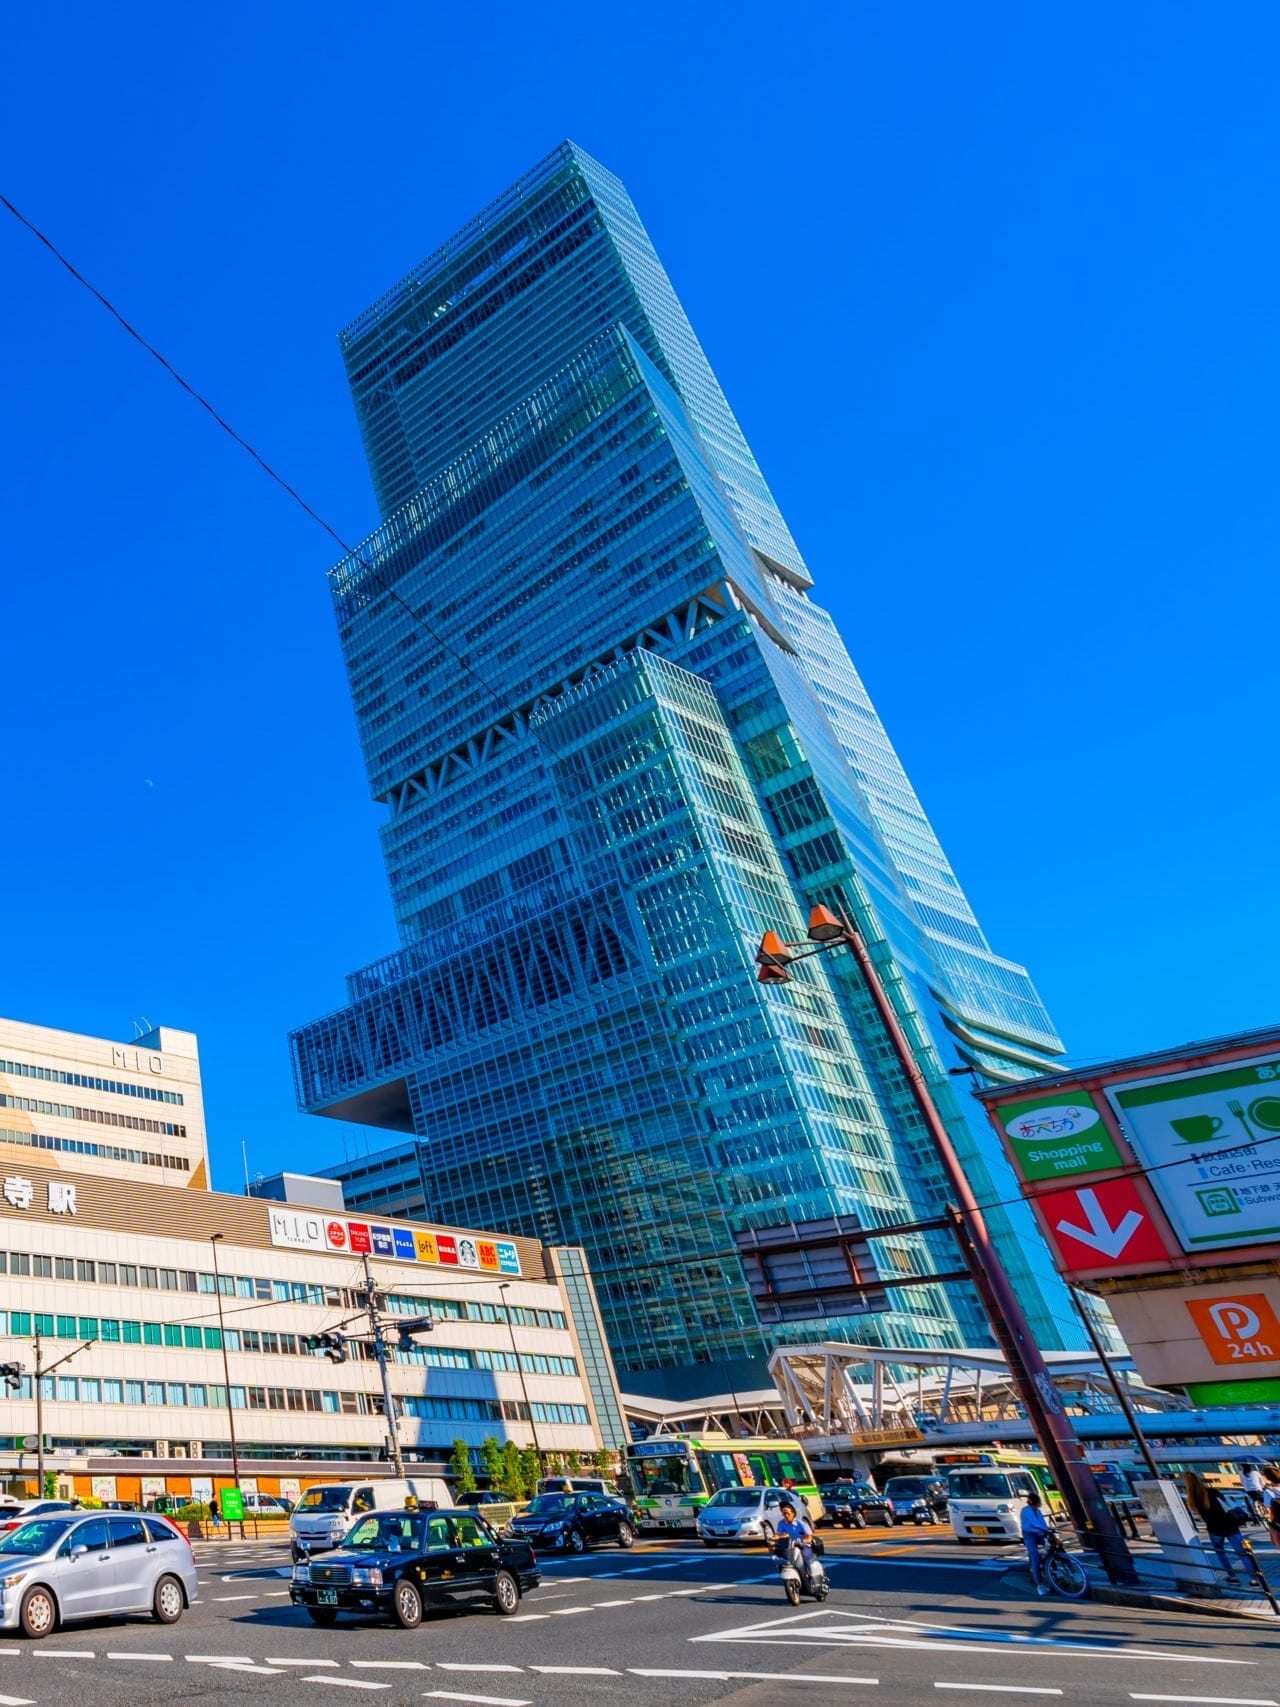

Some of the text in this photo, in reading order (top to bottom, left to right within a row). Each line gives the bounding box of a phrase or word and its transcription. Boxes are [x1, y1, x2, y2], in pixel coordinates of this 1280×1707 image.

[111, 1046, 164, 1075] MIO
[1020, 1117, 1075, 1138] あべちか
[1028, 1142, 1104, 1162] Shopping
[1053, 1155, 1088, 1170] mall
[272, 1214, 320, 1241] MIO
[395, 1240, 414, 1248] PLAZA
[479, 1245, 495, 1257] ABC
[481, 1256, 497, 1266] MART
[499, 1247, 515, 1260] ニトリ
[1226, 1341, 1274, 1358] 24h
